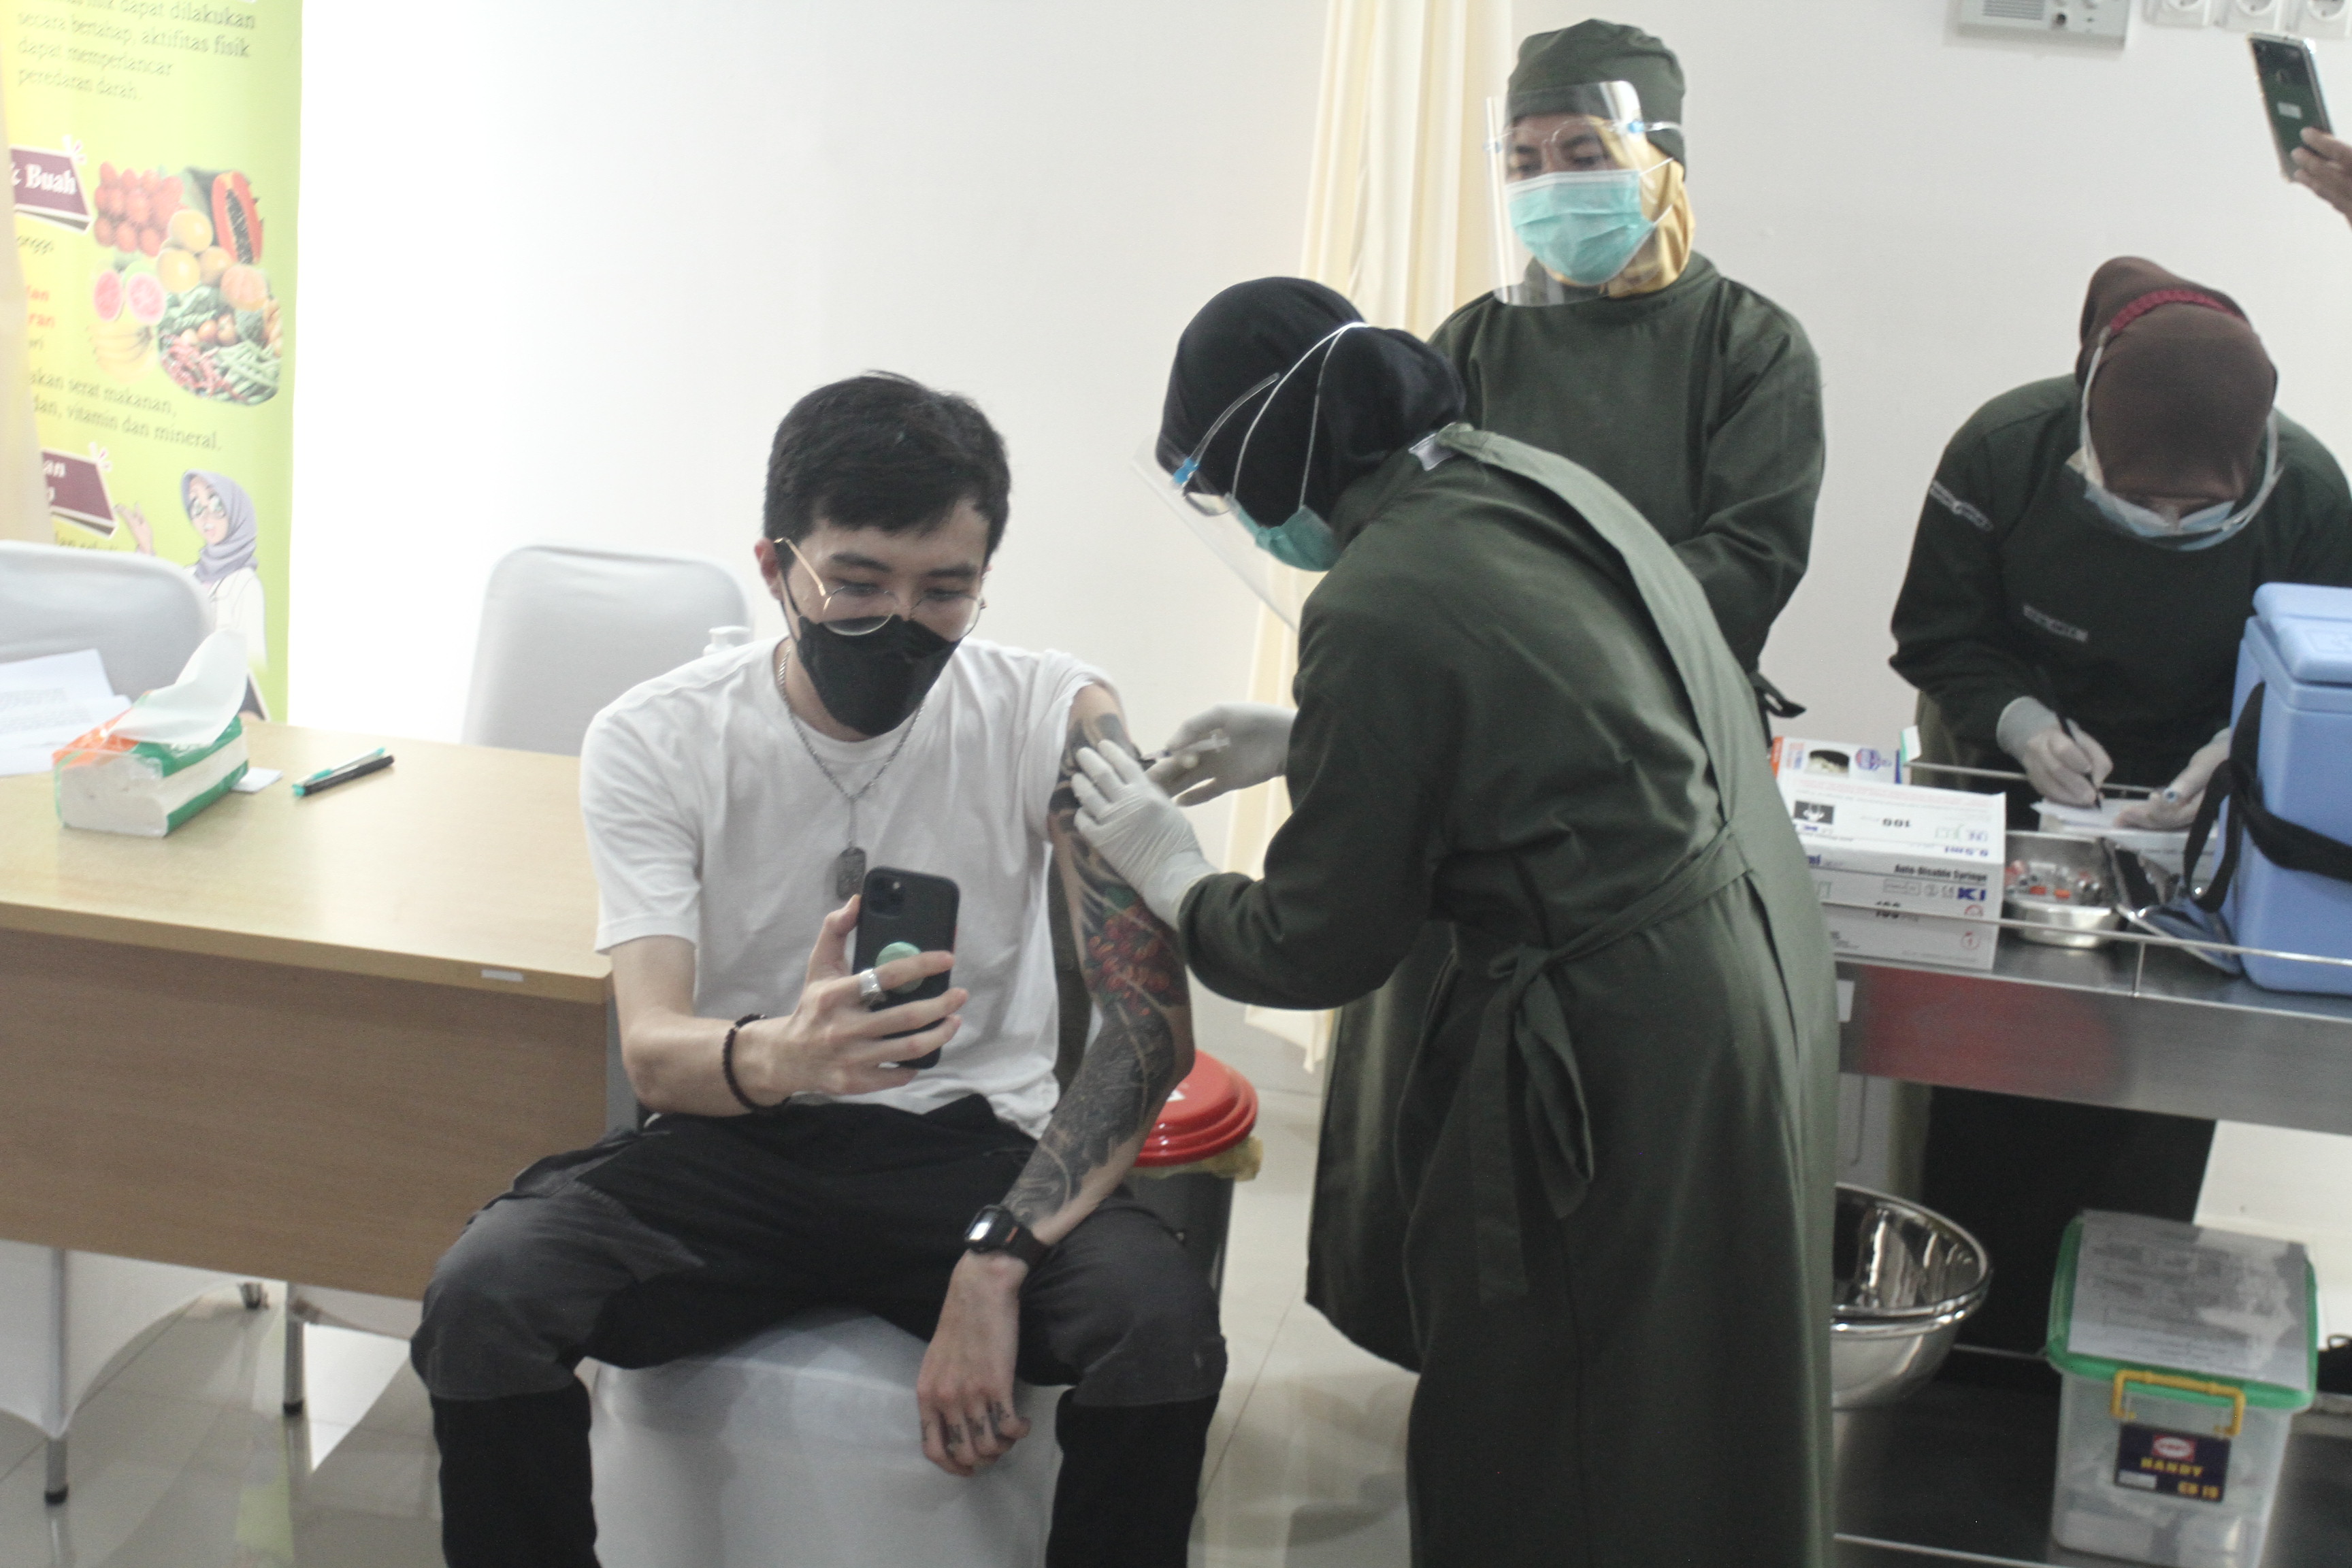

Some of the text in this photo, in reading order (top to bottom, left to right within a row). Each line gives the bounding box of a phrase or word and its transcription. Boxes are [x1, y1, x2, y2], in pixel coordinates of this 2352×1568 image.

[170, 2, 256, 29] dilakukan
[141, 27, 210, 53] aktifitas
[213, 34, 250, 58] fisik
[25, 163, 78, 195] Buah
[67, 401, 118, 434] vitamin
[122, 415, 150, 438] dan
[154, 423, 223, 452] mineral.
